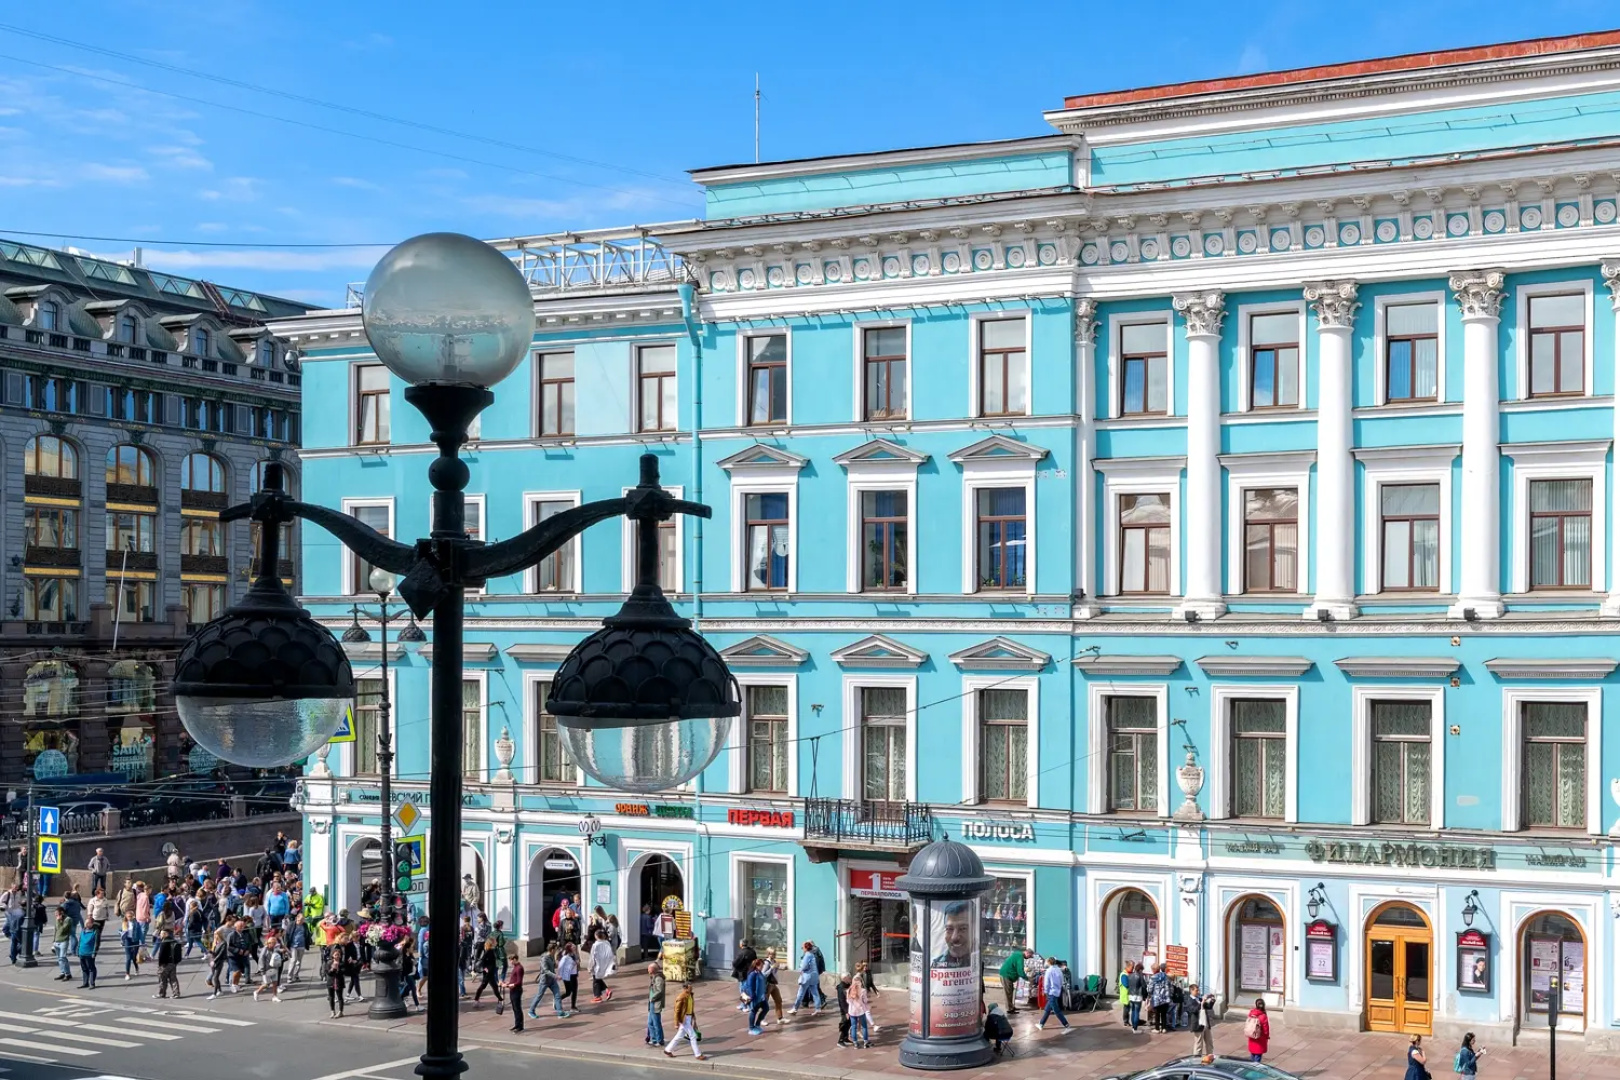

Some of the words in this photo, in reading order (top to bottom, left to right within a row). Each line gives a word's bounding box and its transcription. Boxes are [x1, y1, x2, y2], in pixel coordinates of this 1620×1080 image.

[113, 743, 147, 755] SAINT
[113, 761, 147, 771] PRETTY
[389, 792, 423, 804] ЕВСИЙ
[728, 808, 794, 827] ПЕРВАЯ
[962, 821, 1034, 840] ПОЛОСА
[1306, 839, 1496, 870] ФИЛАРМОНИЯ
[868, 873, 880, 891] 1
[930, 968, 972, 981] Брачное
